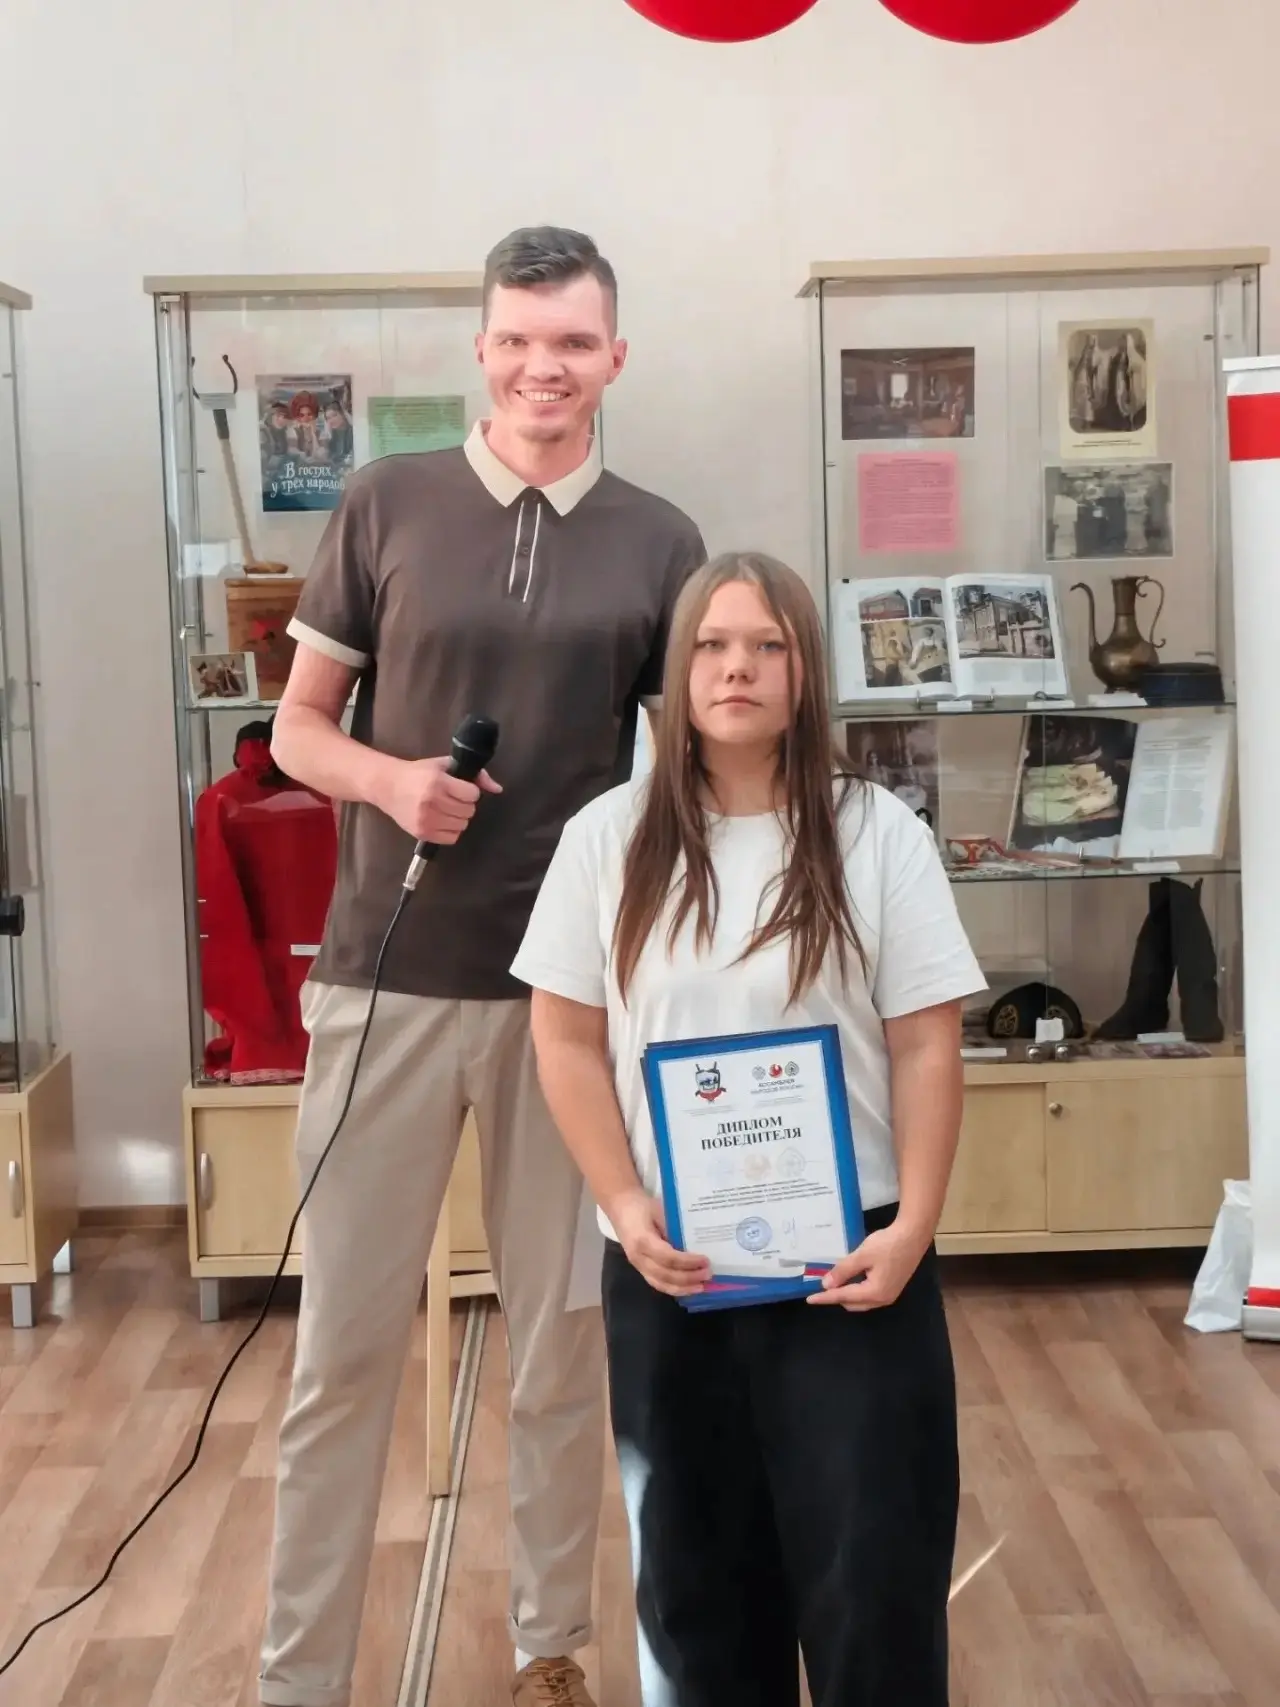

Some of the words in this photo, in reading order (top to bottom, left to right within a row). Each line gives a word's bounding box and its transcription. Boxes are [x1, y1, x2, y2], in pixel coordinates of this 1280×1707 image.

[284, 461, 295, 479] В
[298, 466, 332, 478] гостях
[716, 1115, 783, 1136] ДИПЛОМ
[701, 1127, 802, 1151] ПОБЕДИТЕЛЯ
